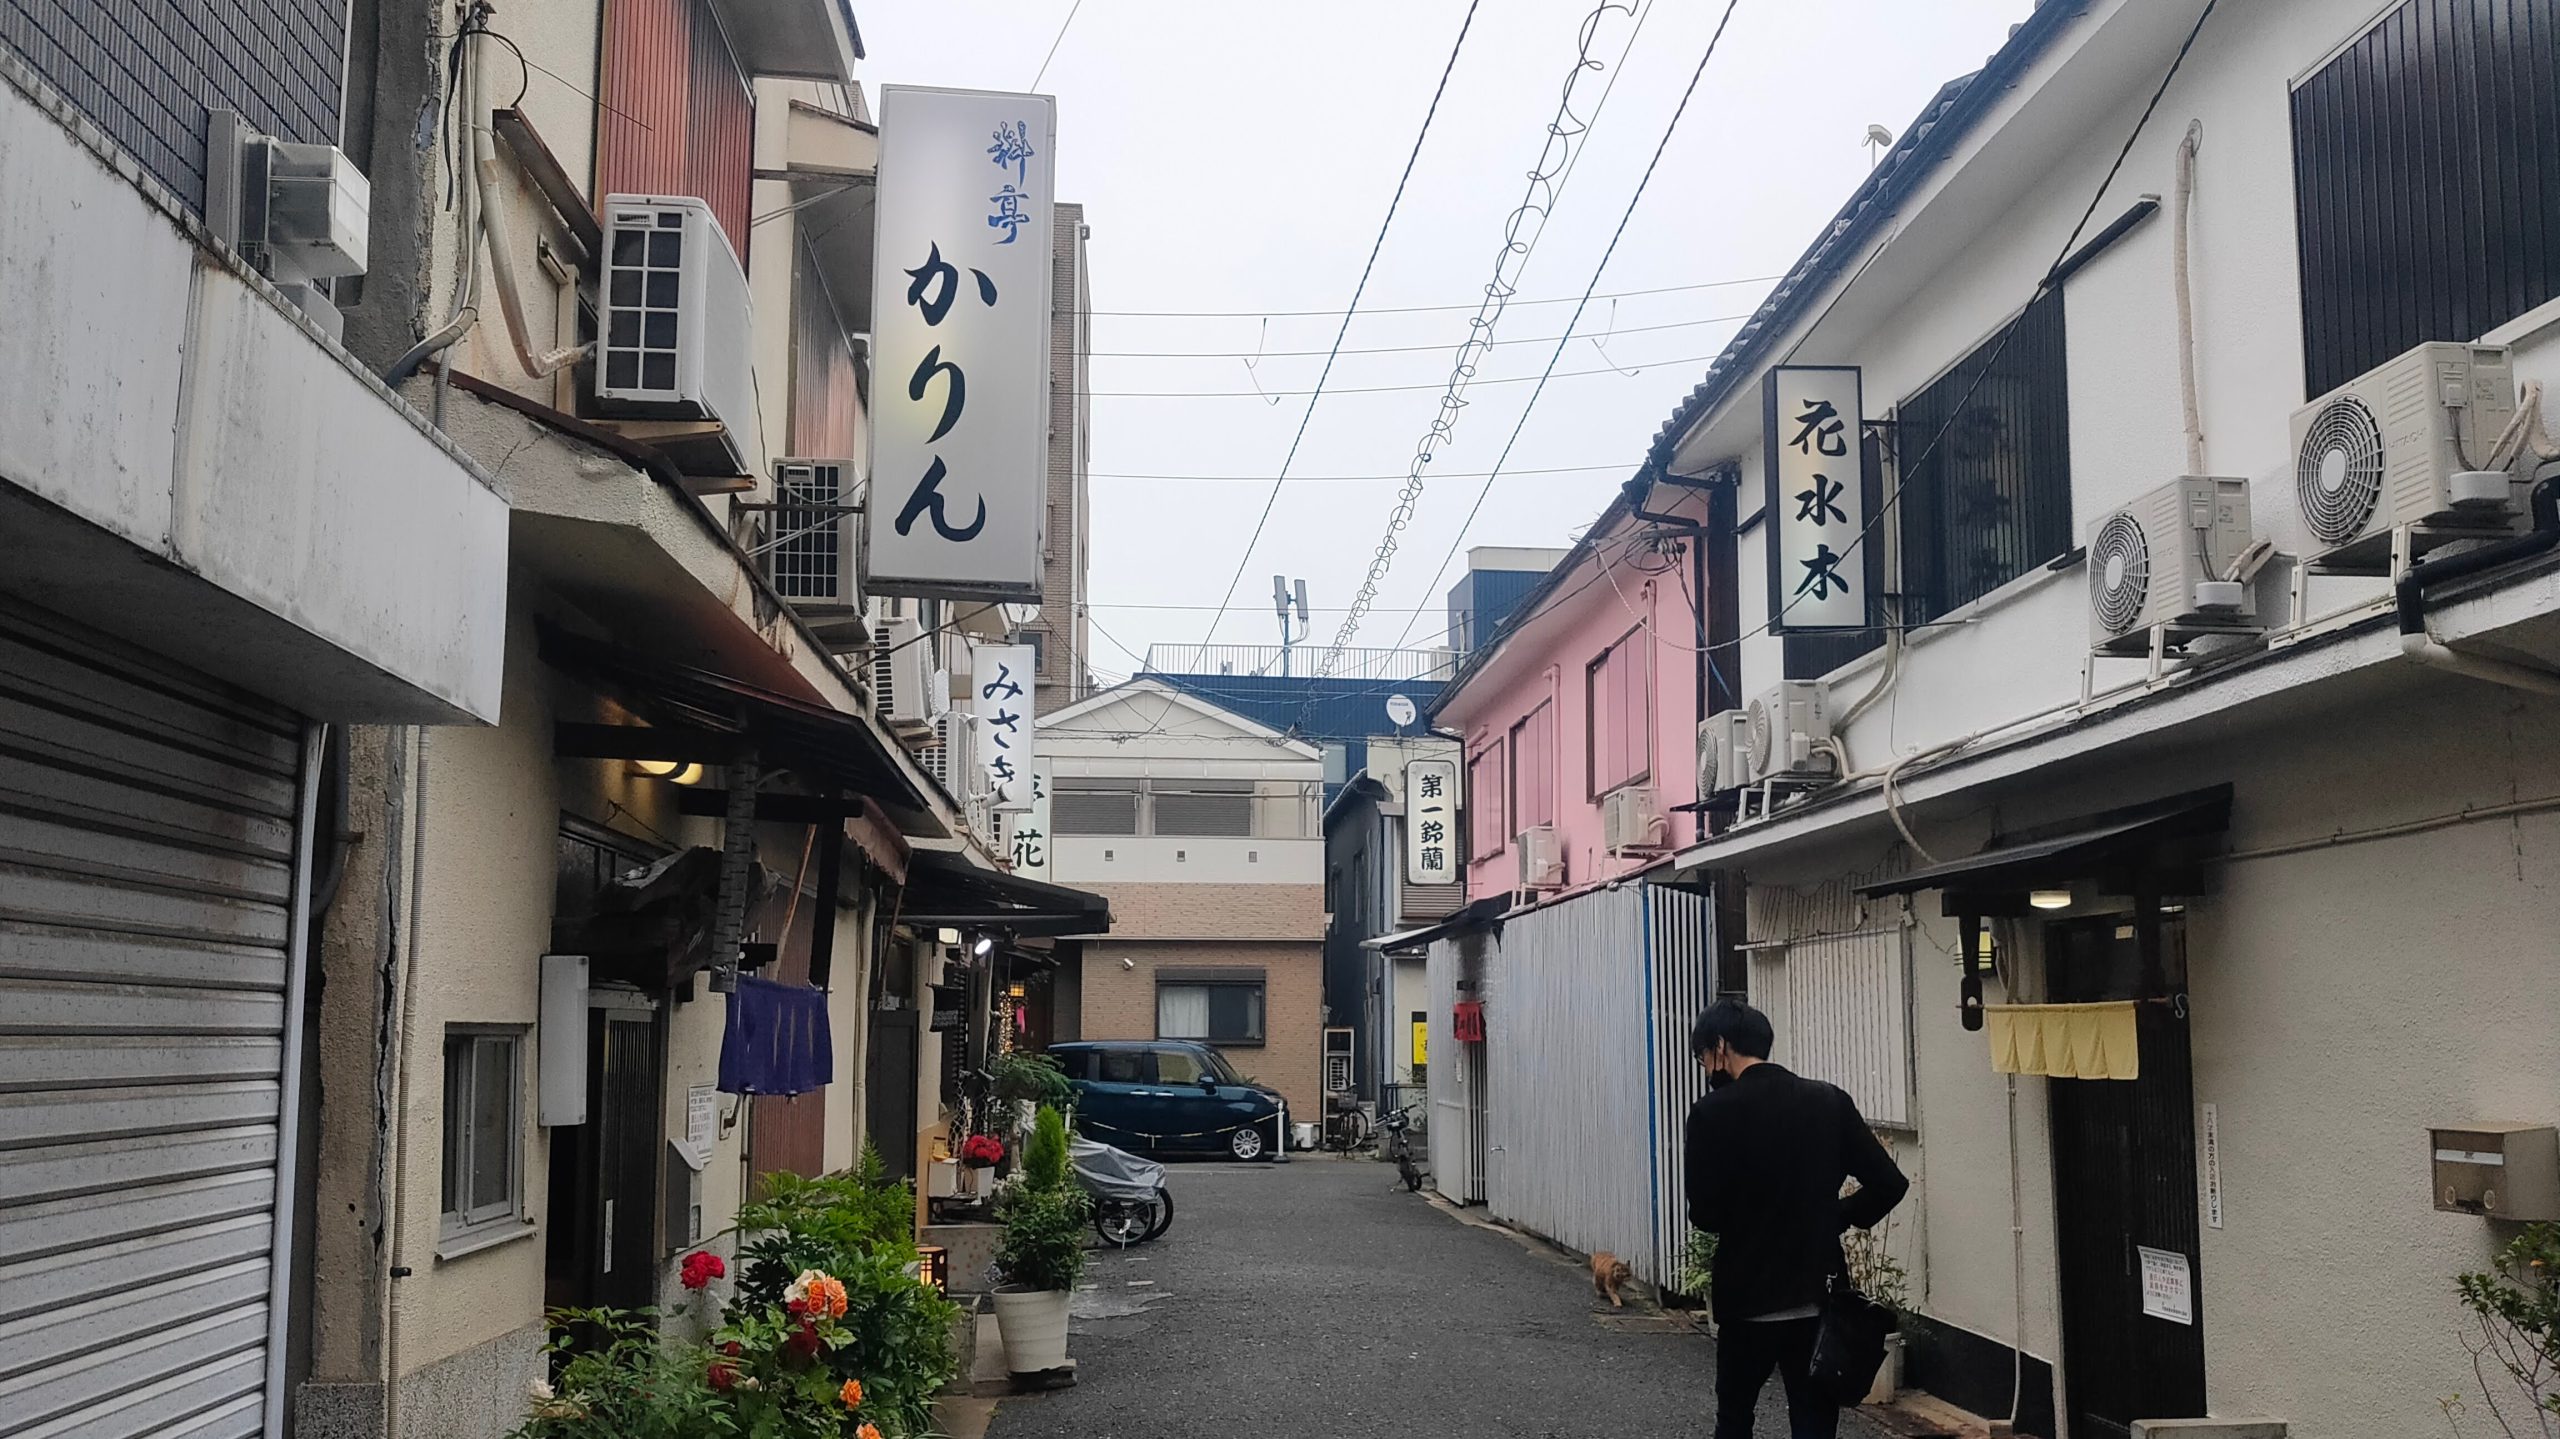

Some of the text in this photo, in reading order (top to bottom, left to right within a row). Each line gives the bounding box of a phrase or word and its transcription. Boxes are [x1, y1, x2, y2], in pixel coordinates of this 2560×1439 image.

[986, 120, 1035, 245] 料亭
[894, 240, 998, 543] かりん
[1788, 399, 1849, 601] 花水木
[1420, 774, 1444, 870] 第一鈴蘭
